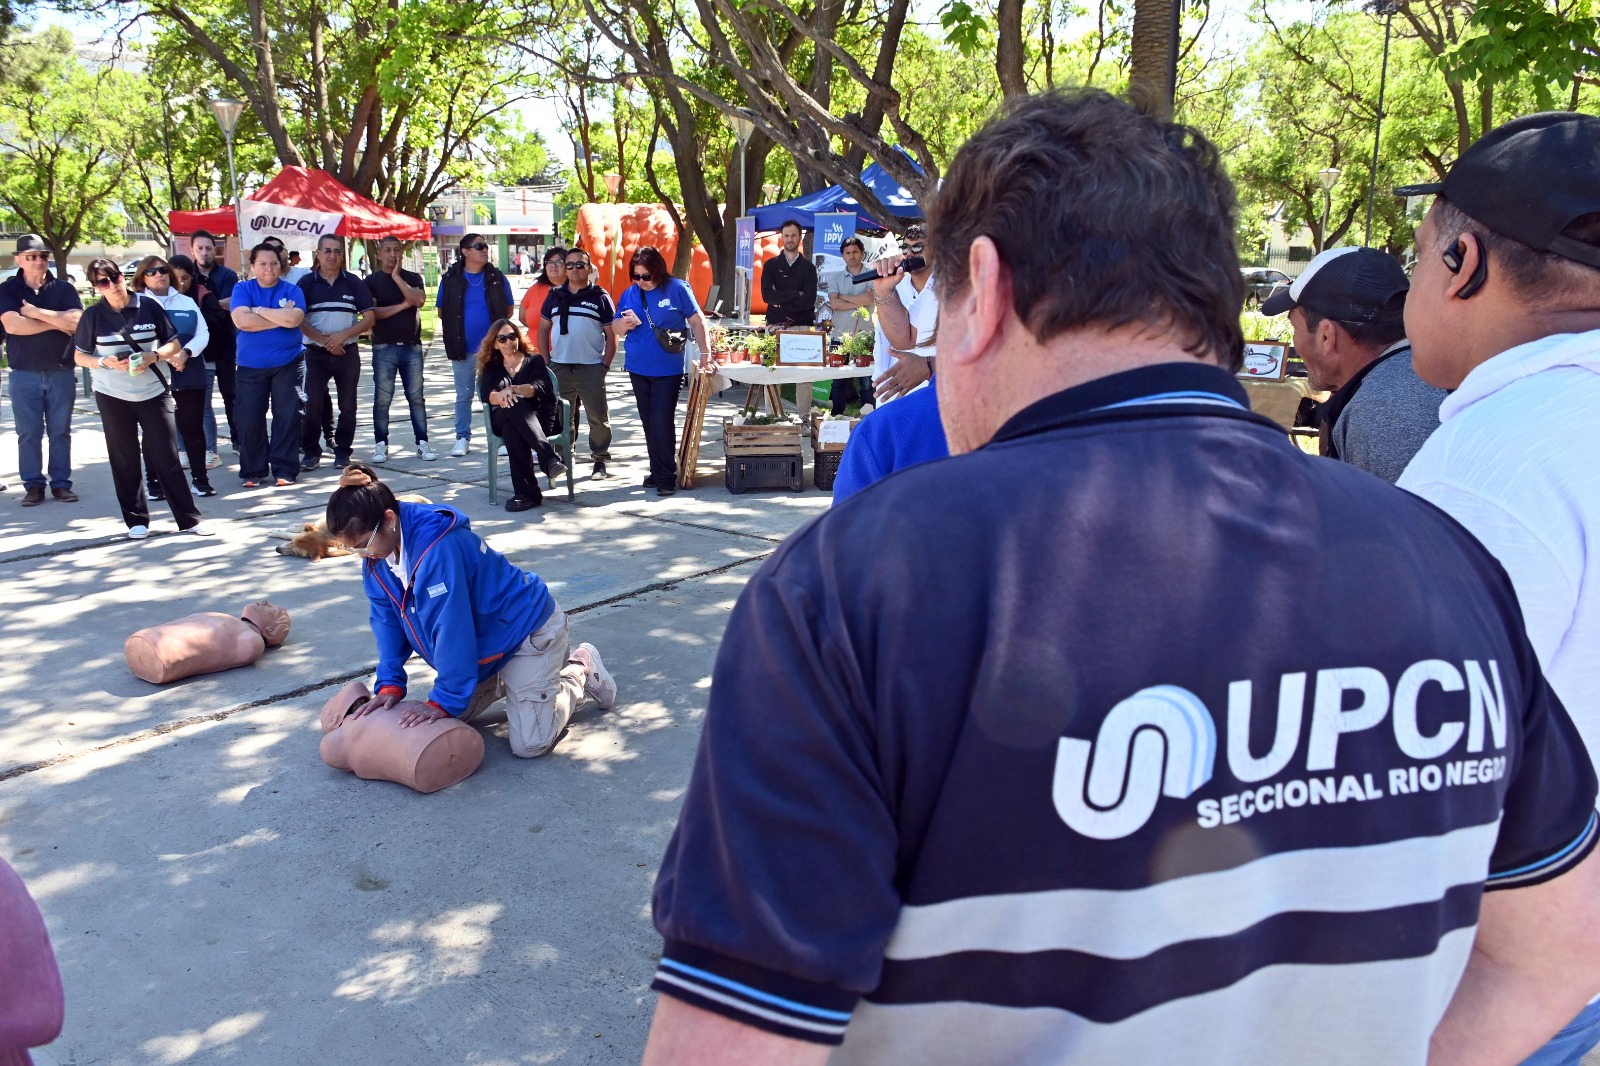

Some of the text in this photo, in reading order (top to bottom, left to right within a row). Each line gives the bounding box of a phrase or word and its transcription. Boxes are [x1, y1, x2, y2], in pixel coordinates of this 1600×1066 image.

[271, 216, 325, 235] UPCN
[824, 232, 843, 243] IPPV
[1226, 658, 1507, 783] UPCN
[1197, 773, 1383, 828] SECCIONAL
[1388, 764, 1442, 796] RIO
